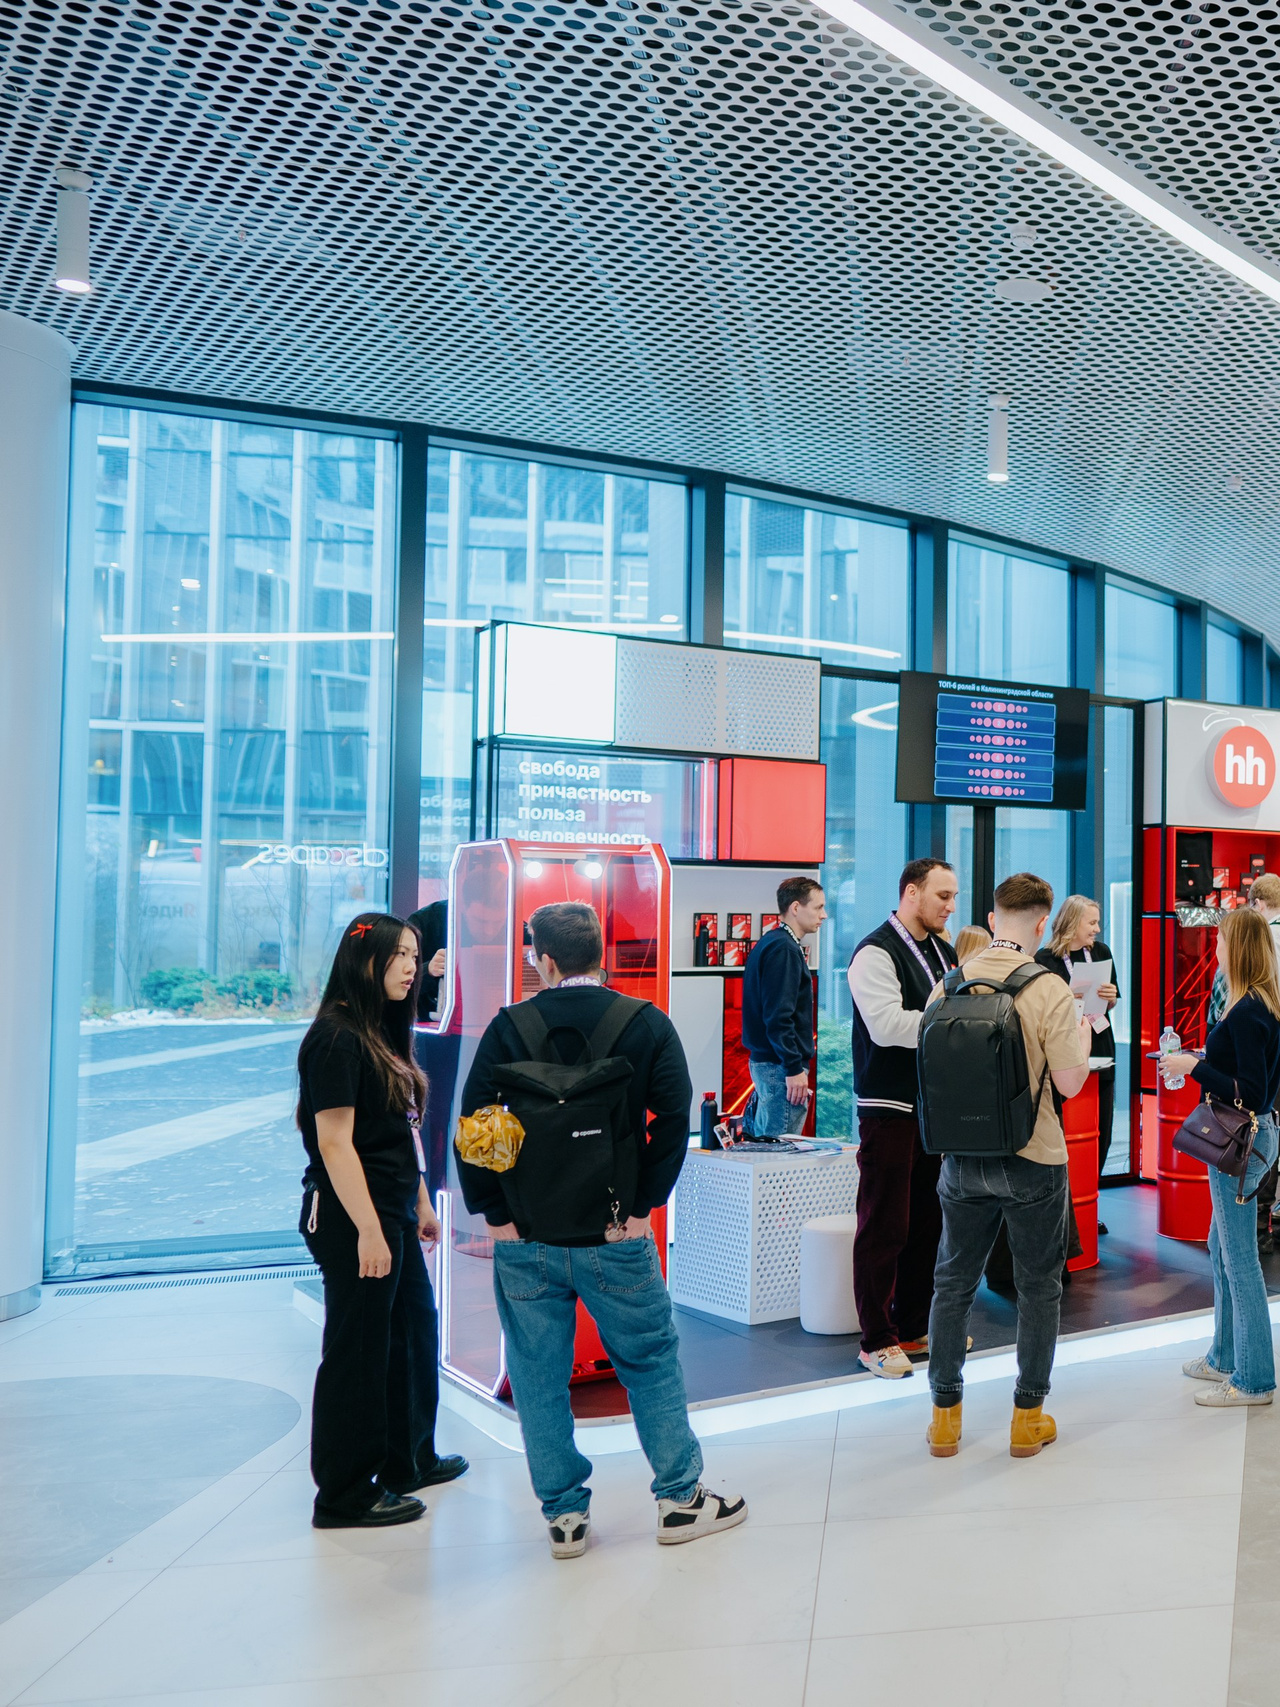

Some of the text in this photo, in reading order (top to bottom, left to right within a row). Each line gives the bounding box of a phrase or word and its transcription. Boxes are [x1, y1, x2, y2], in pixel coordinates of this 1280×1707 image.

[938, 680, 957, 690] ТОП-6
[957, 683, 976, 692] ролей
[981, 684, 1031, 697] Калининградской
[1031, 690, 1054, 699] области
[518, 760, 601, 780] свобода
[1225, 744, 1266, 786] hh
[518, 784, 653, 804] причастность
[518, 806, 586, 823] польза
[518, 829, 653, 845] человечность
